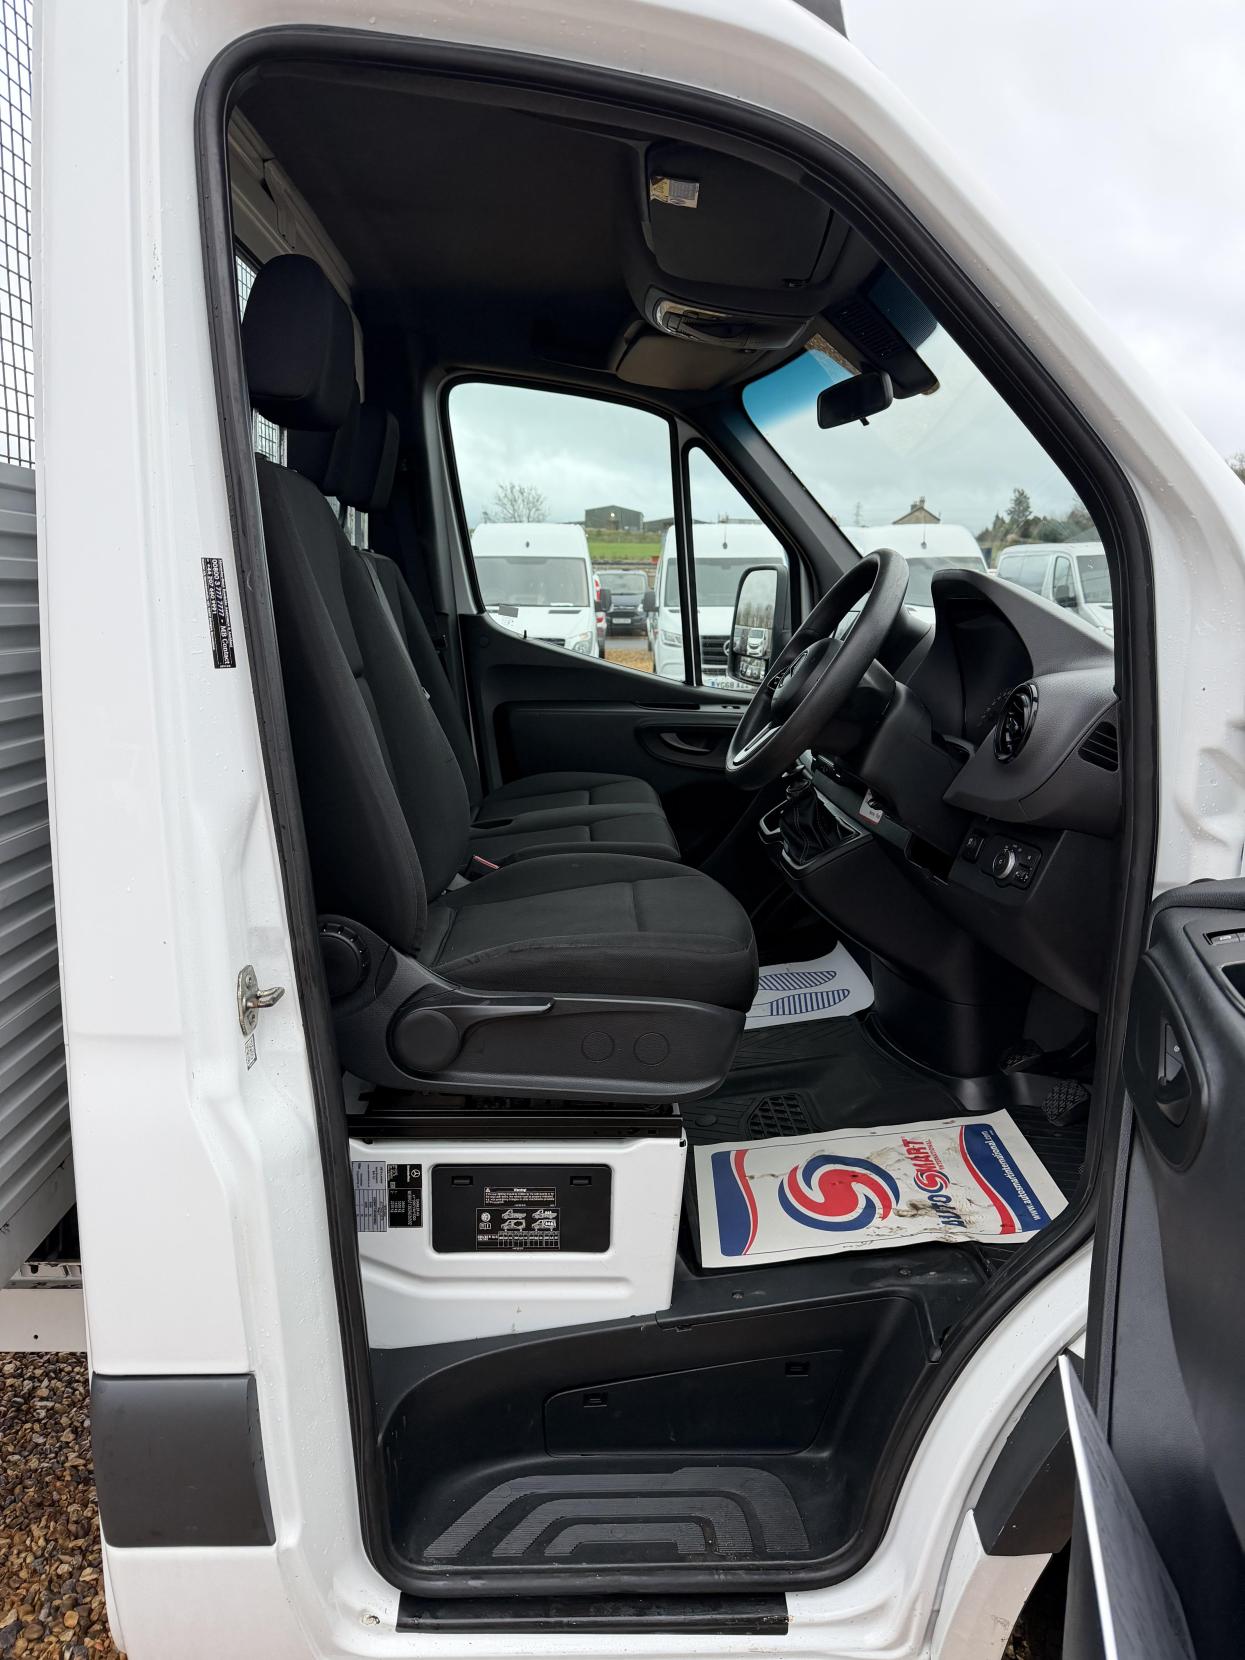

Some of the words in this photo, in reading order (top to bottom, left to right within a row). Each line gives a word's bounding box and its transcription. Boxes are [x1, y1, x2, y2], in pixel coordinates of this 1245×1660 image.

[217, 600, 225, 617] 7777
[220, 625, 227, 638] MB
[221, 638, 230, 665] Contact
[981, 1130, 1041, 1221] www.autosmartinternational.com
